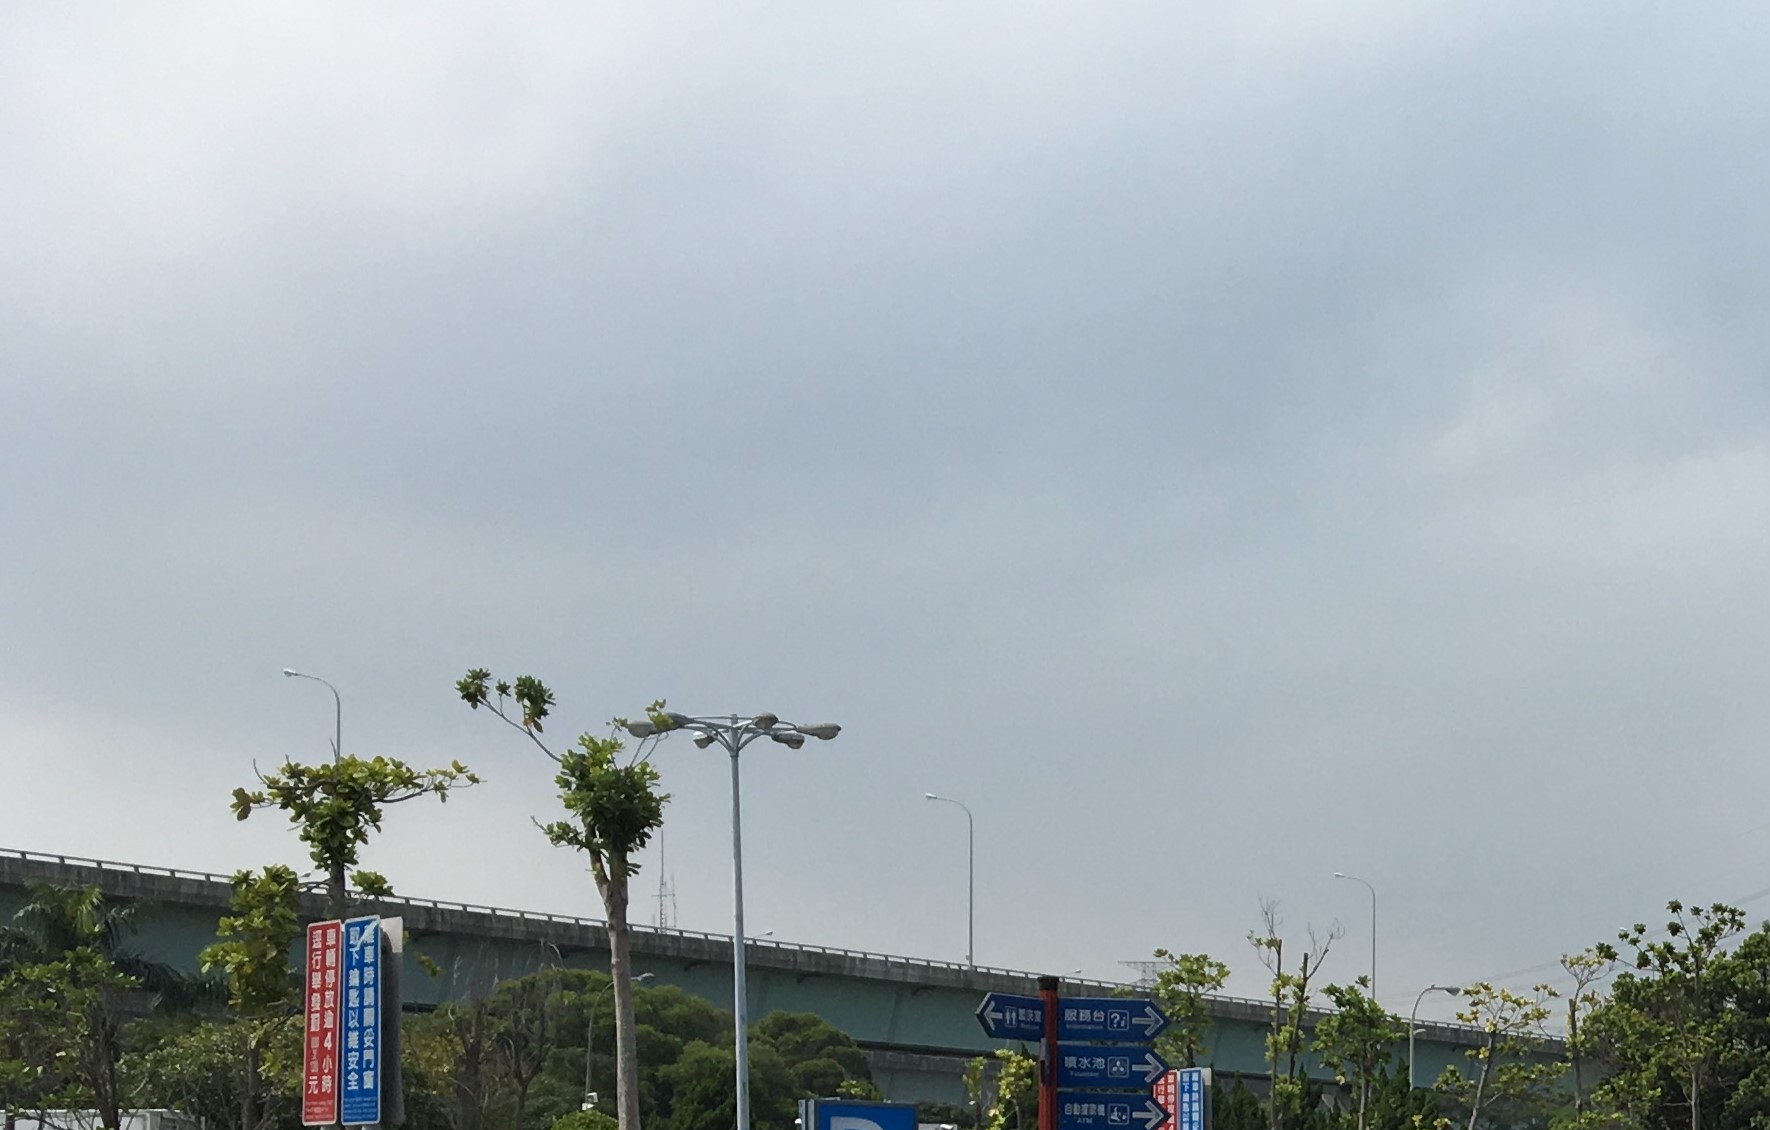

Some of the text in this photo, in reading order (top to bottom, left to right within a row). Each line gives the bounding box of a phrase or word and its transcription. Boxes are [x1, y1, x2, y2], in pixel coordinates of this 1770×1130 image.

[1064, 1008, 1105, 1022] 服務台
[1064, 1056, 1105, 1070] 噴水池
